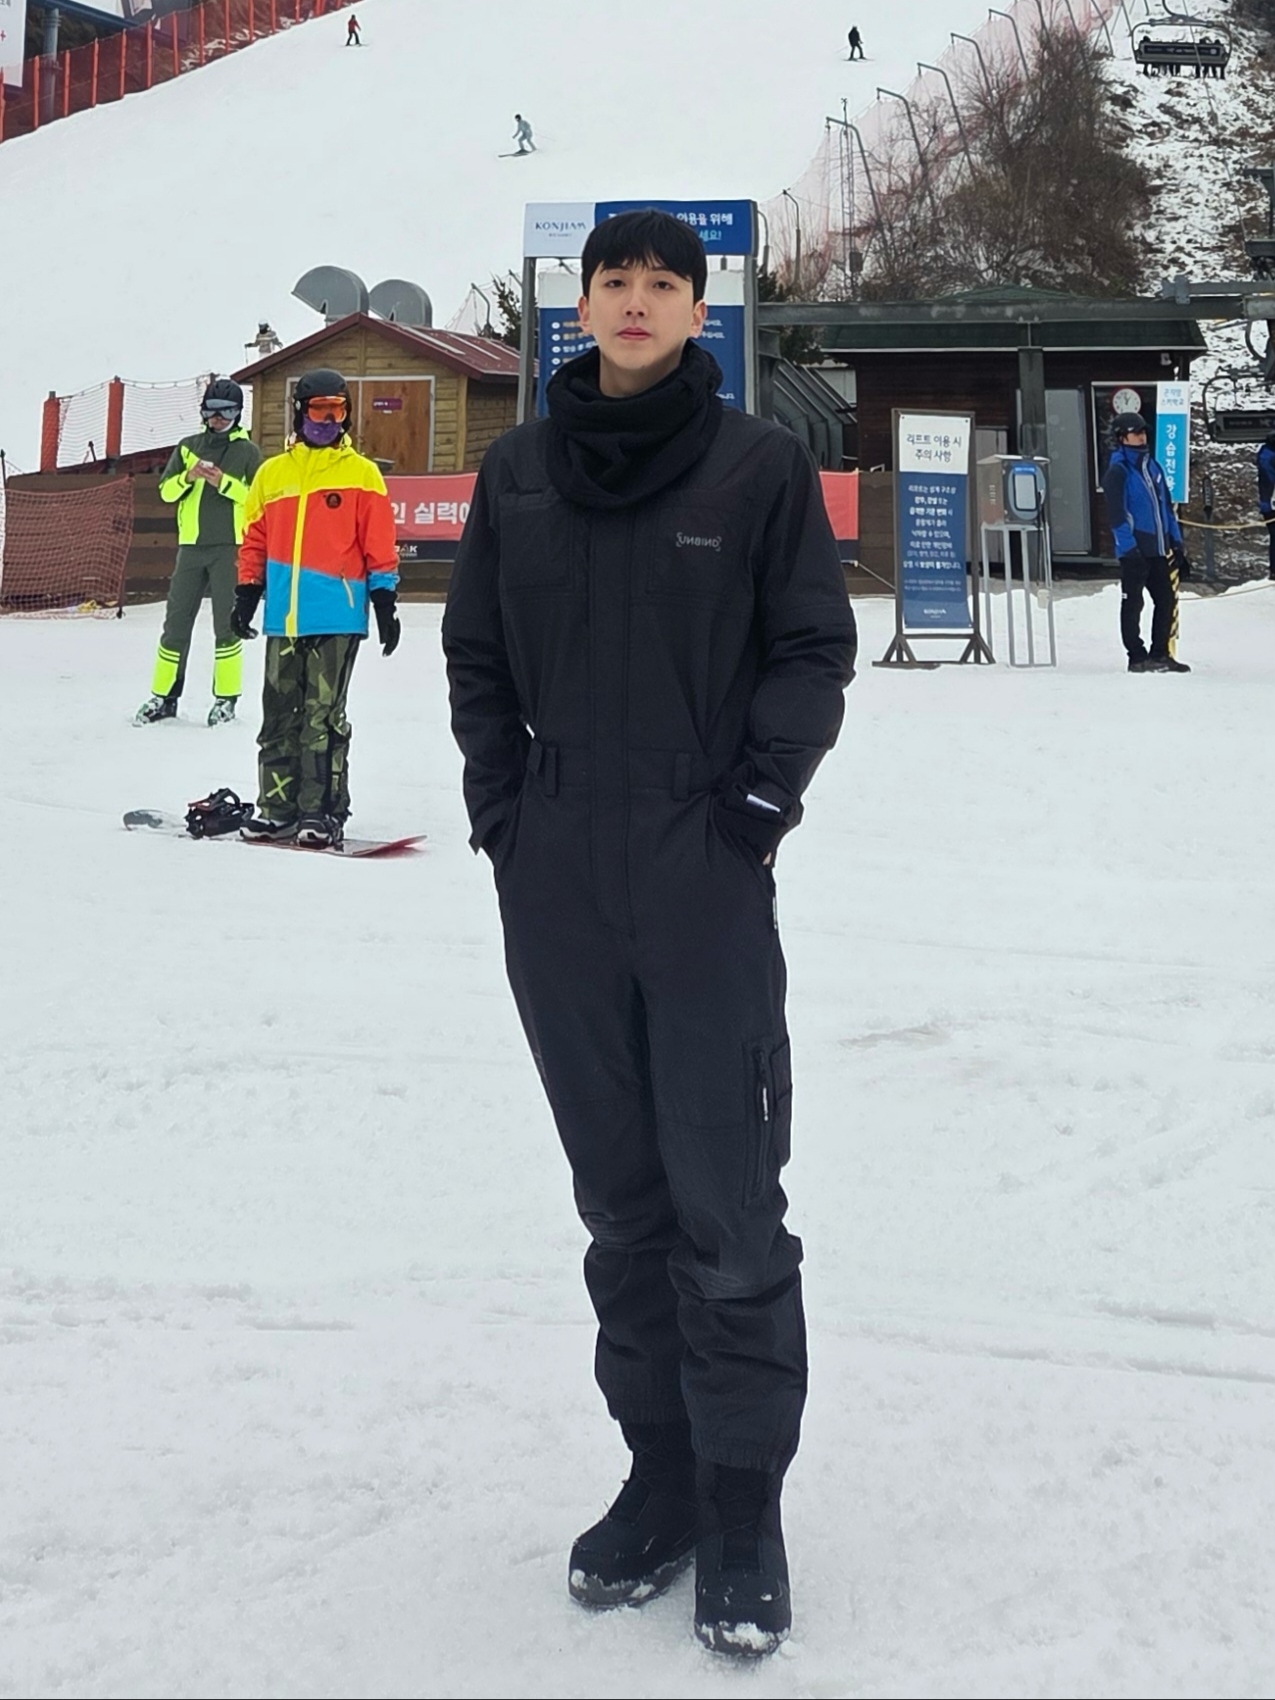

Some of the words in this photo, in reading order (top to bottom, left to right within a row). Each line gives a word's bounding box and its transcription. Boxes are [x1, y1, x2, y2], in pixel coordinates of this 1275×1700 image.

[676, 212, 707, 226] 이용을
[709, 212, 733, 226] 위해
[535, 222, 587, 232] KONJIAM
[699, 229, 722, 242] 세요!
[906, 433, 931, 445] 리프트
[933, 434, 950, 448] 이용
[952, 436, 962, 448] 시
[915, 449, 932, 461] 주의
[934, 450, 951, 463] 사항
[390, 502, 406, 524] 인
